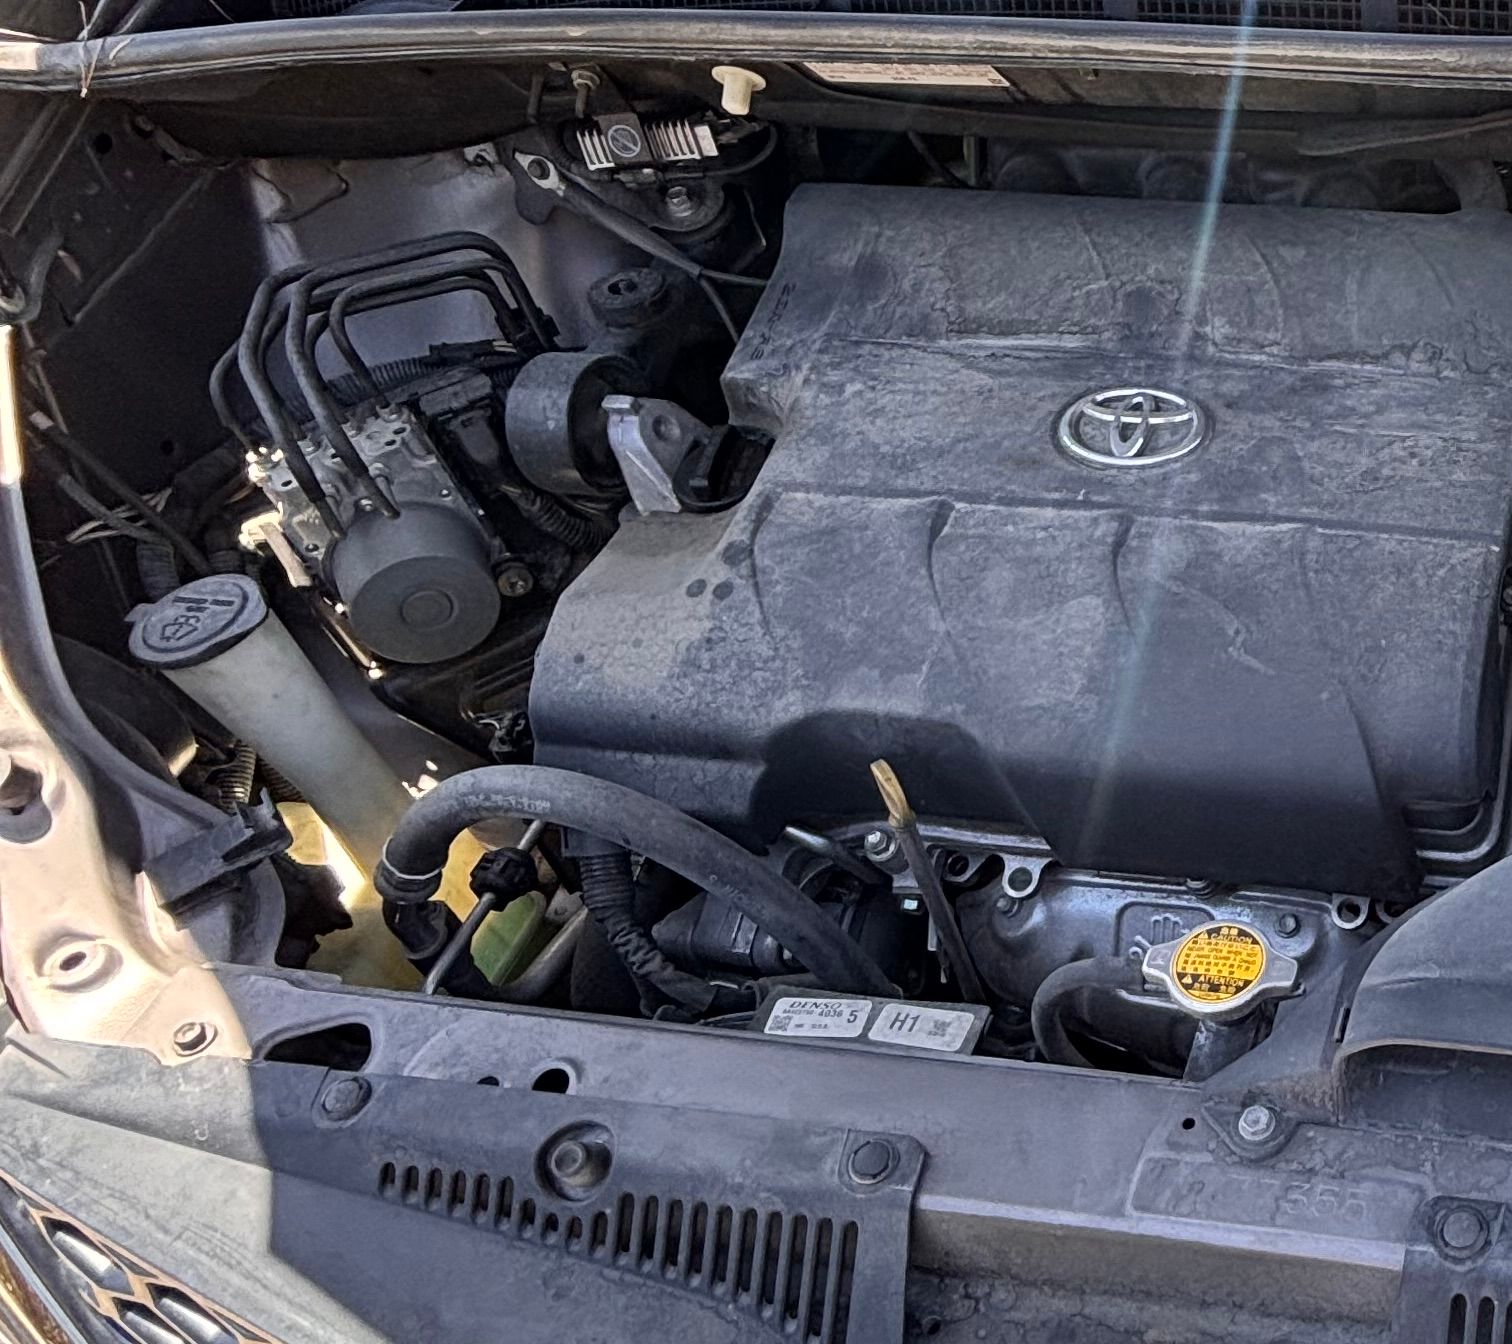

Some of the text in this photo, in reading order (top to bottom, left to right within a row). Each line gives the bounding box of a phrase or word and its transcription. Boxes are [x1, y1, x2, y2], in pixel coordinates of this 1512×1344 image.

[1211, 933, 1253, 944] CAUTION
[1198, 975, 1245, 987] ATTENTION
[789, 1001, 842, 1010] DENSO
[847, 1010, 859, 1023] 5
[889, 1012, 921, 1033] H1
